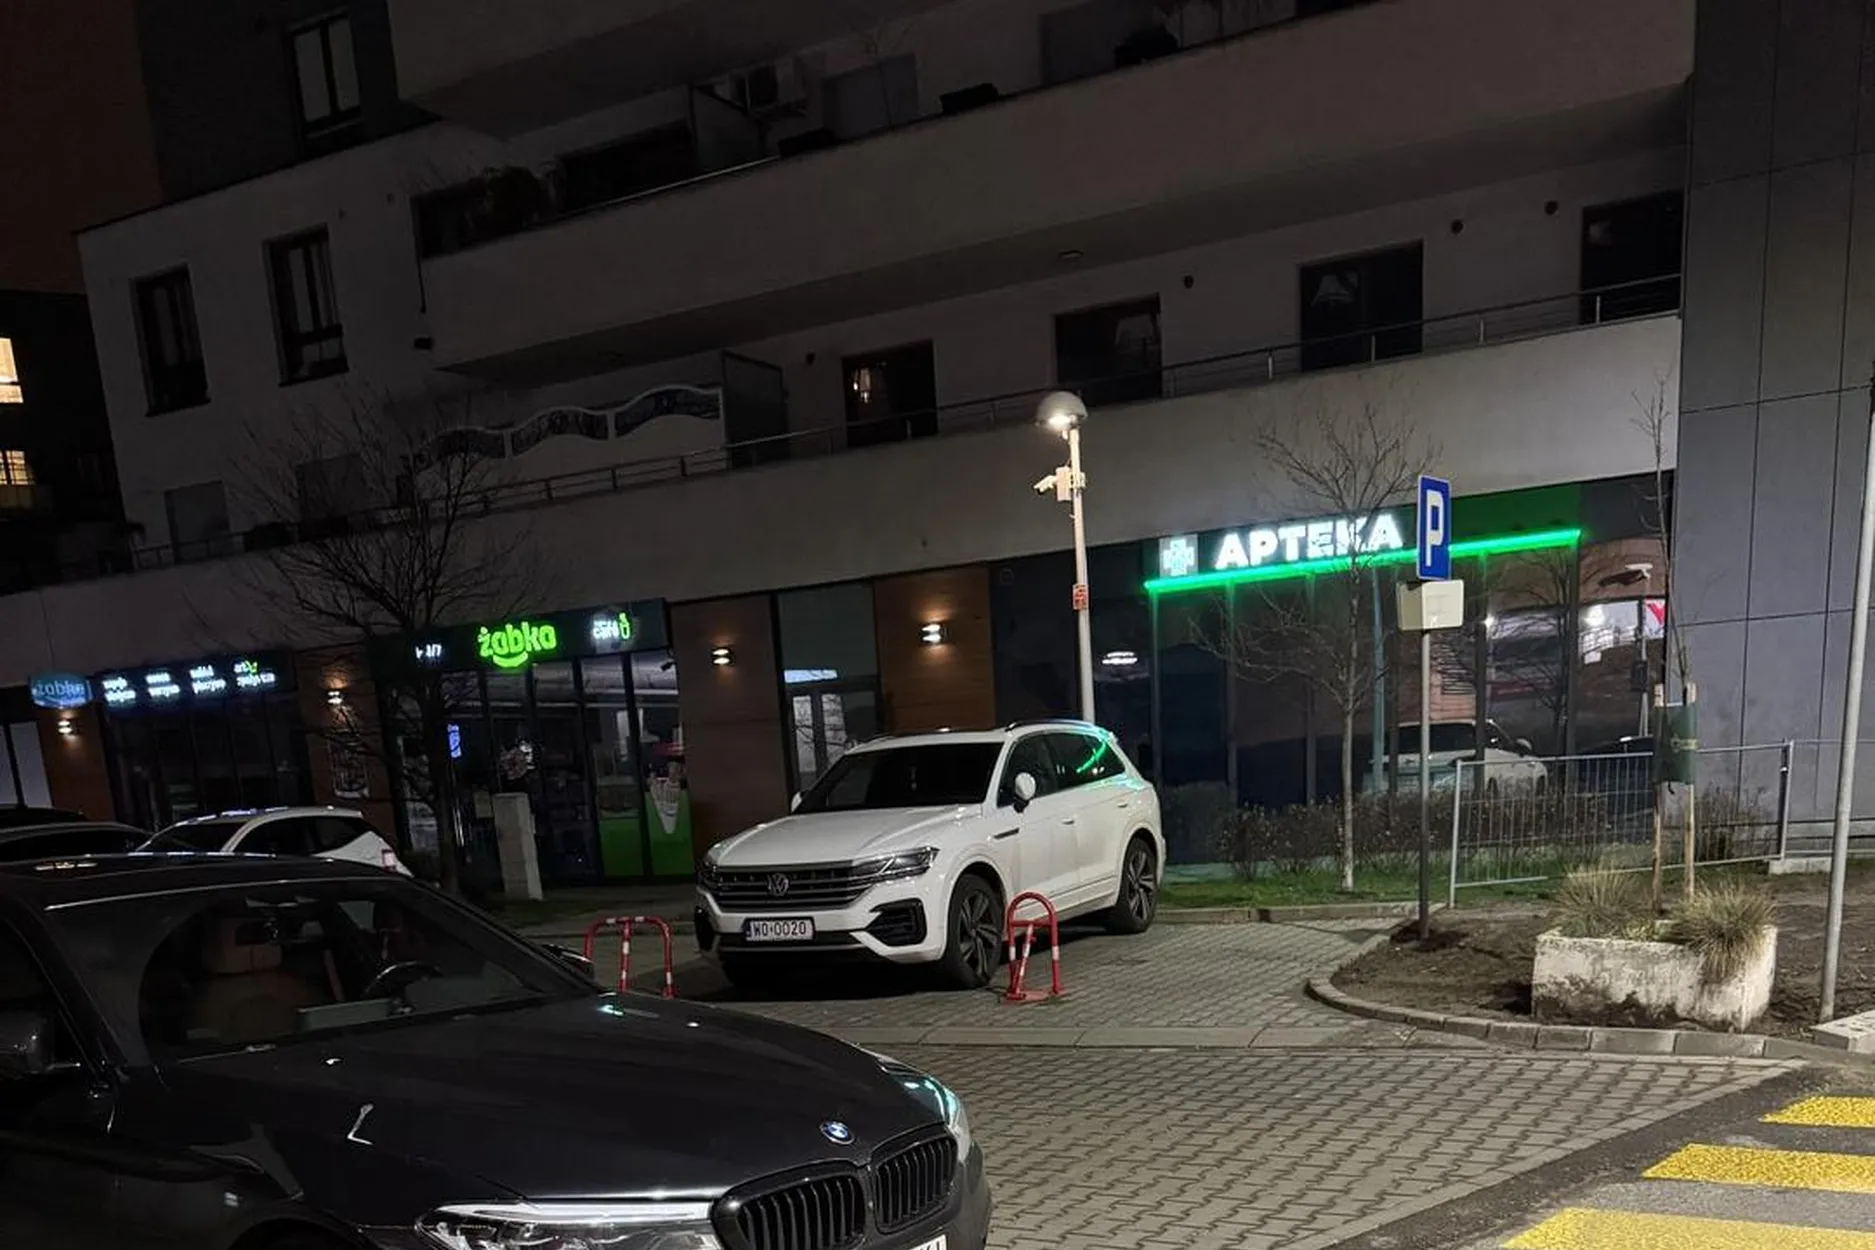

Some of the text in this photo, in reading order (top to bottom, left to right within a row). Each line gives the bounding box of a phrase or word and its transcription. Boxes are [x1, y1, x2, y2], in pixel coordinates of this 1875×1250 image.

[1215, 513, 1404, 570] APTEKA
[1425, 490, 1445, 568] P
[478, 622, 556, 658] żabka
